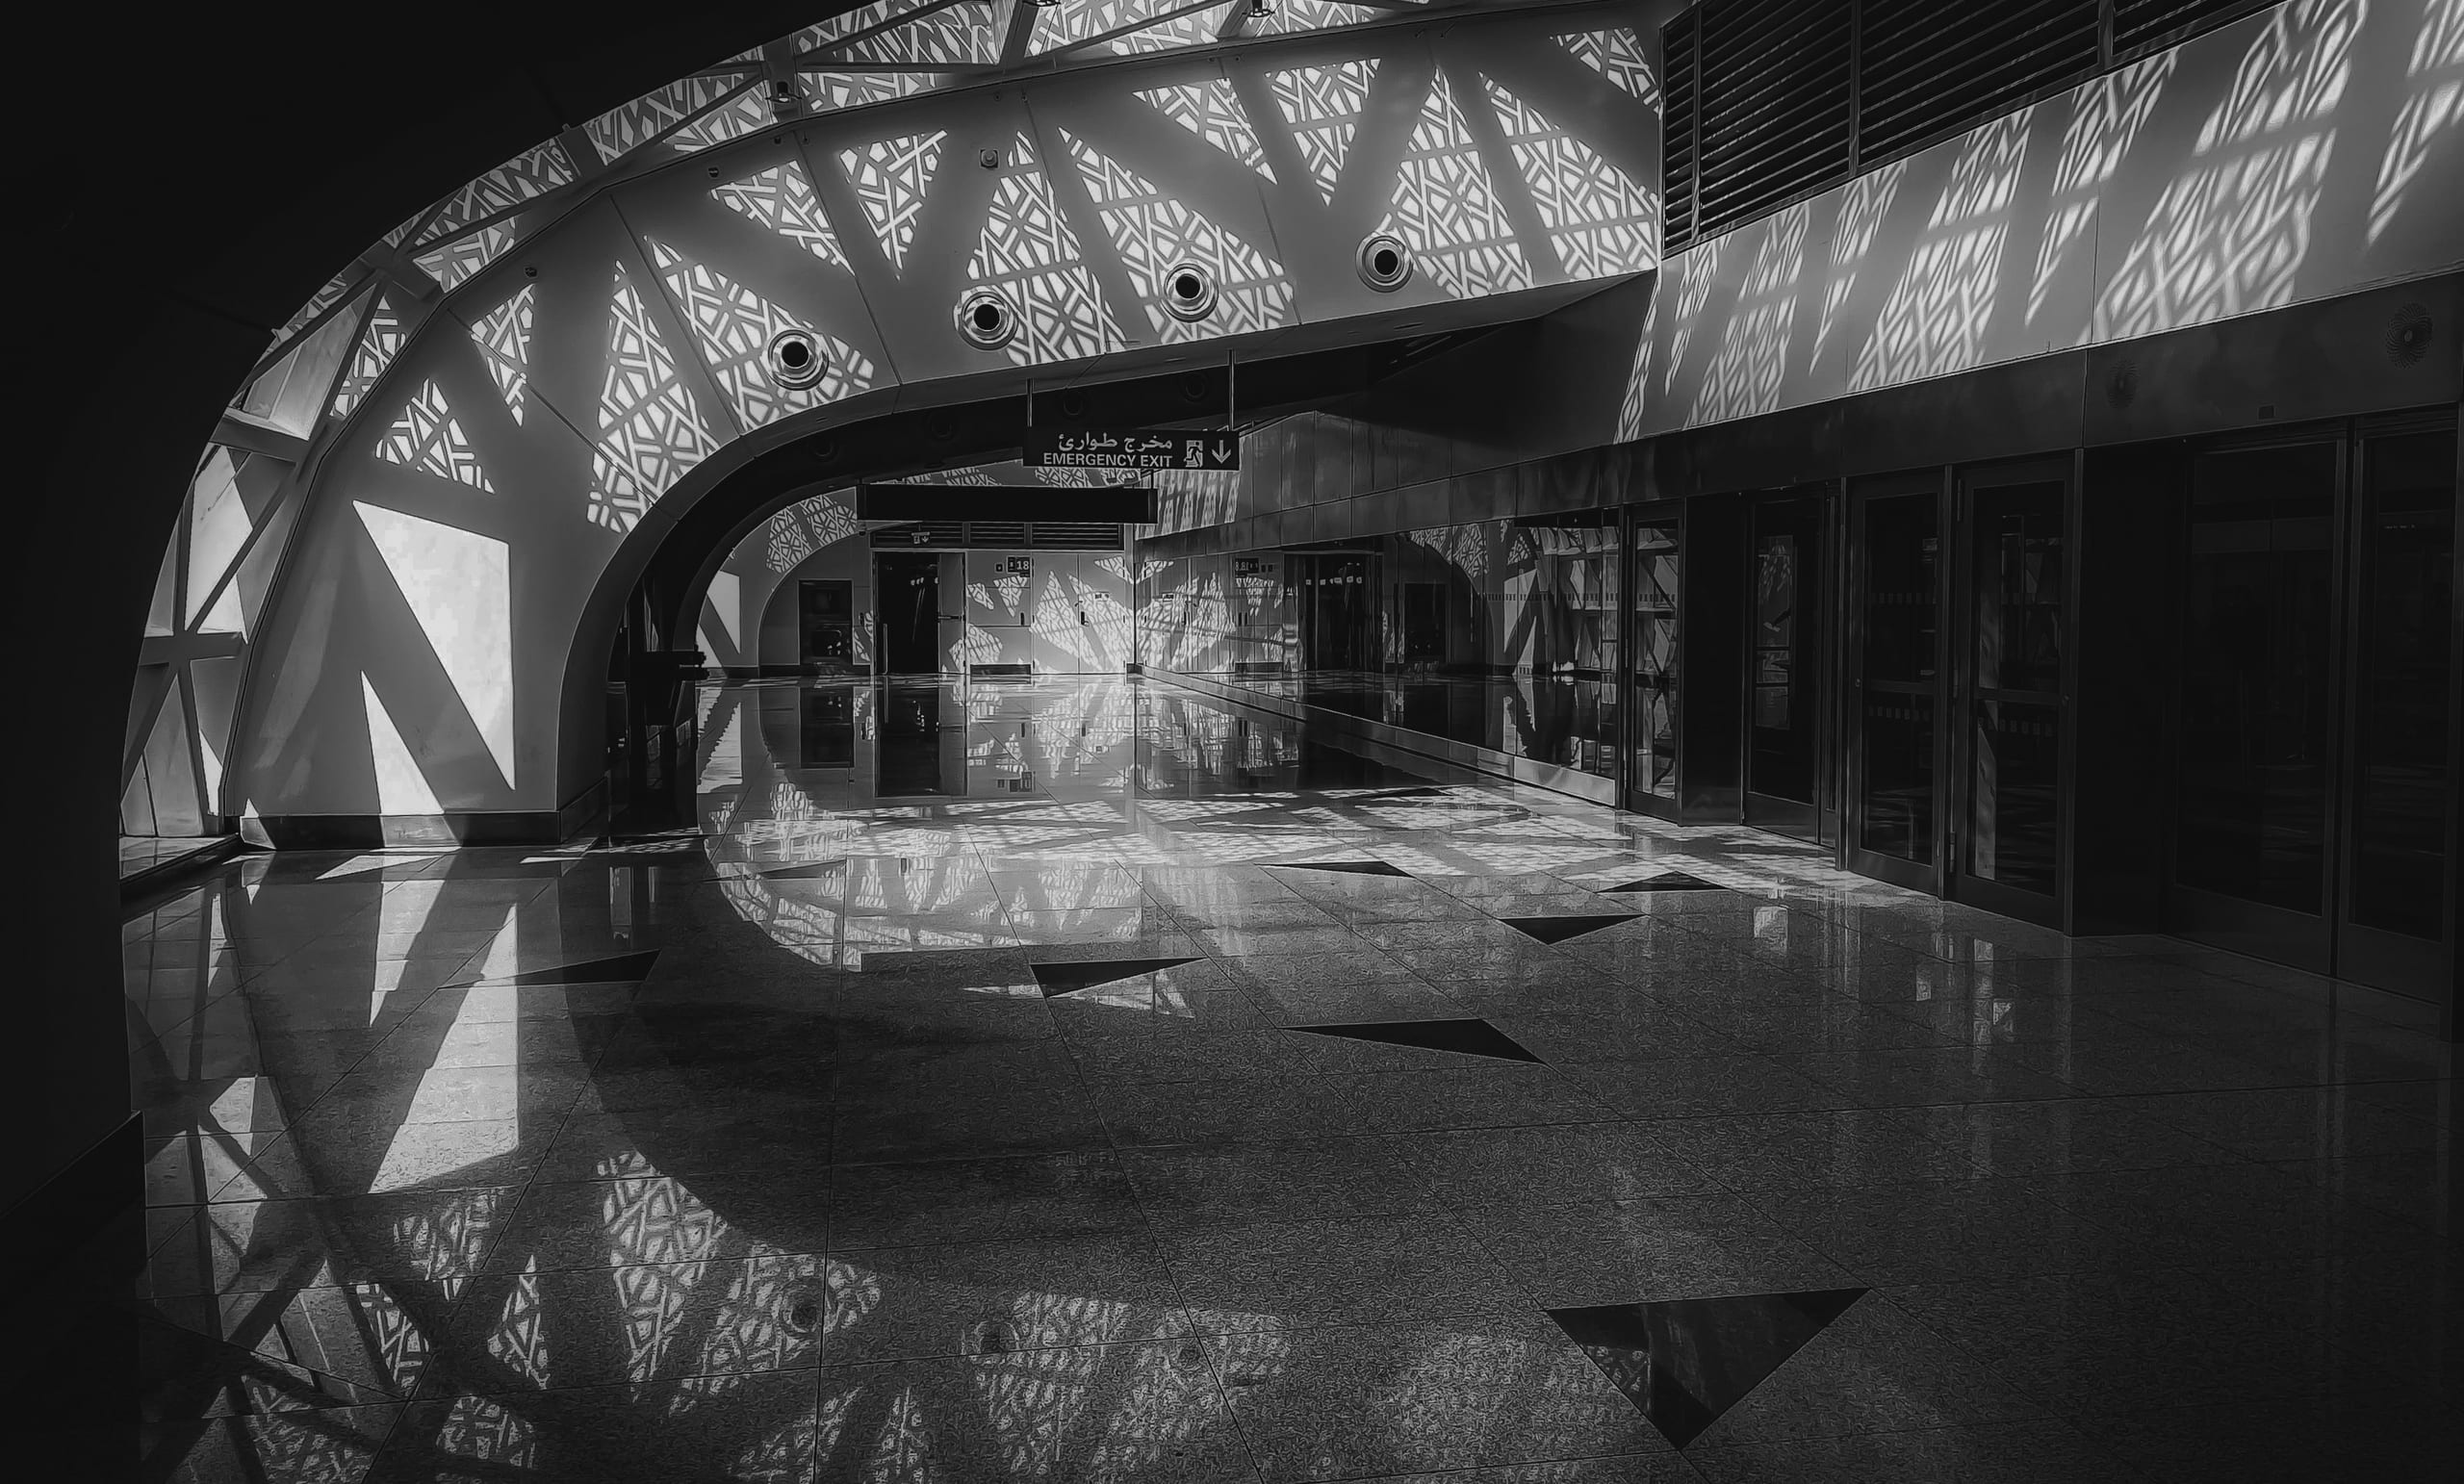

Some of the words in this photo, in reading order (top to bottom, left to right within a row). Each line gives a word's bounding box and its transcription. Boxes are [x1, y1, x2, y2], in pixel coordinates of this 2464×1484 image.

[1059, 431, 1117, 451] طوارئ
[1124, 435, 1172, 452] مخرج
[1043, 452, 1136, 466] EMERGENCY
[1141, 455, 1172, 467] EXIT
[1016, 560, 1029, 570] 18
